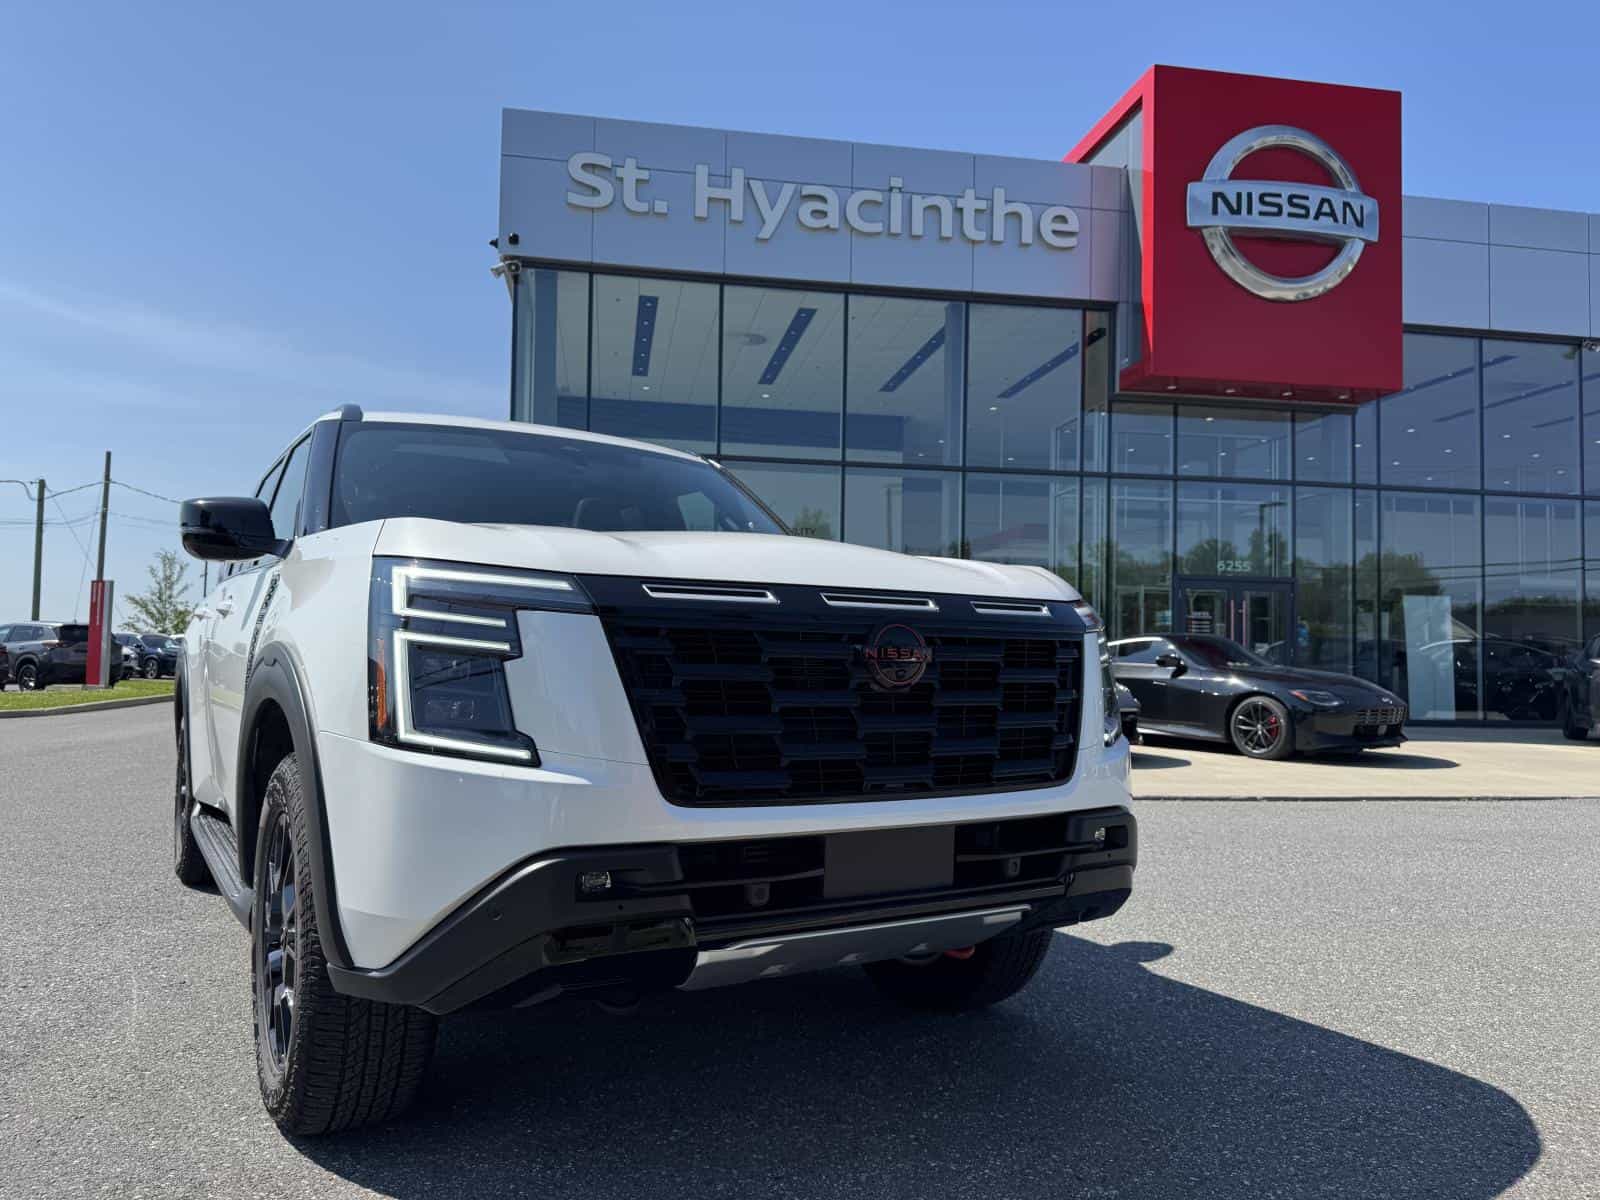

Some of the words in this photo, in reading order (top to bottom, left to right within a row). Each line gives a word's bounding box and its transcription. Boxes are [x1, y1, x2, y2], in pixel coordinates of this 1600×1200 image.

[566, 151, 668, 215] St.
[694, 164, 1080, 250] Hyacinthe
[1211, 191, 1365, 229] NISSAN
[1216, 560, 1251, 573] 6255
